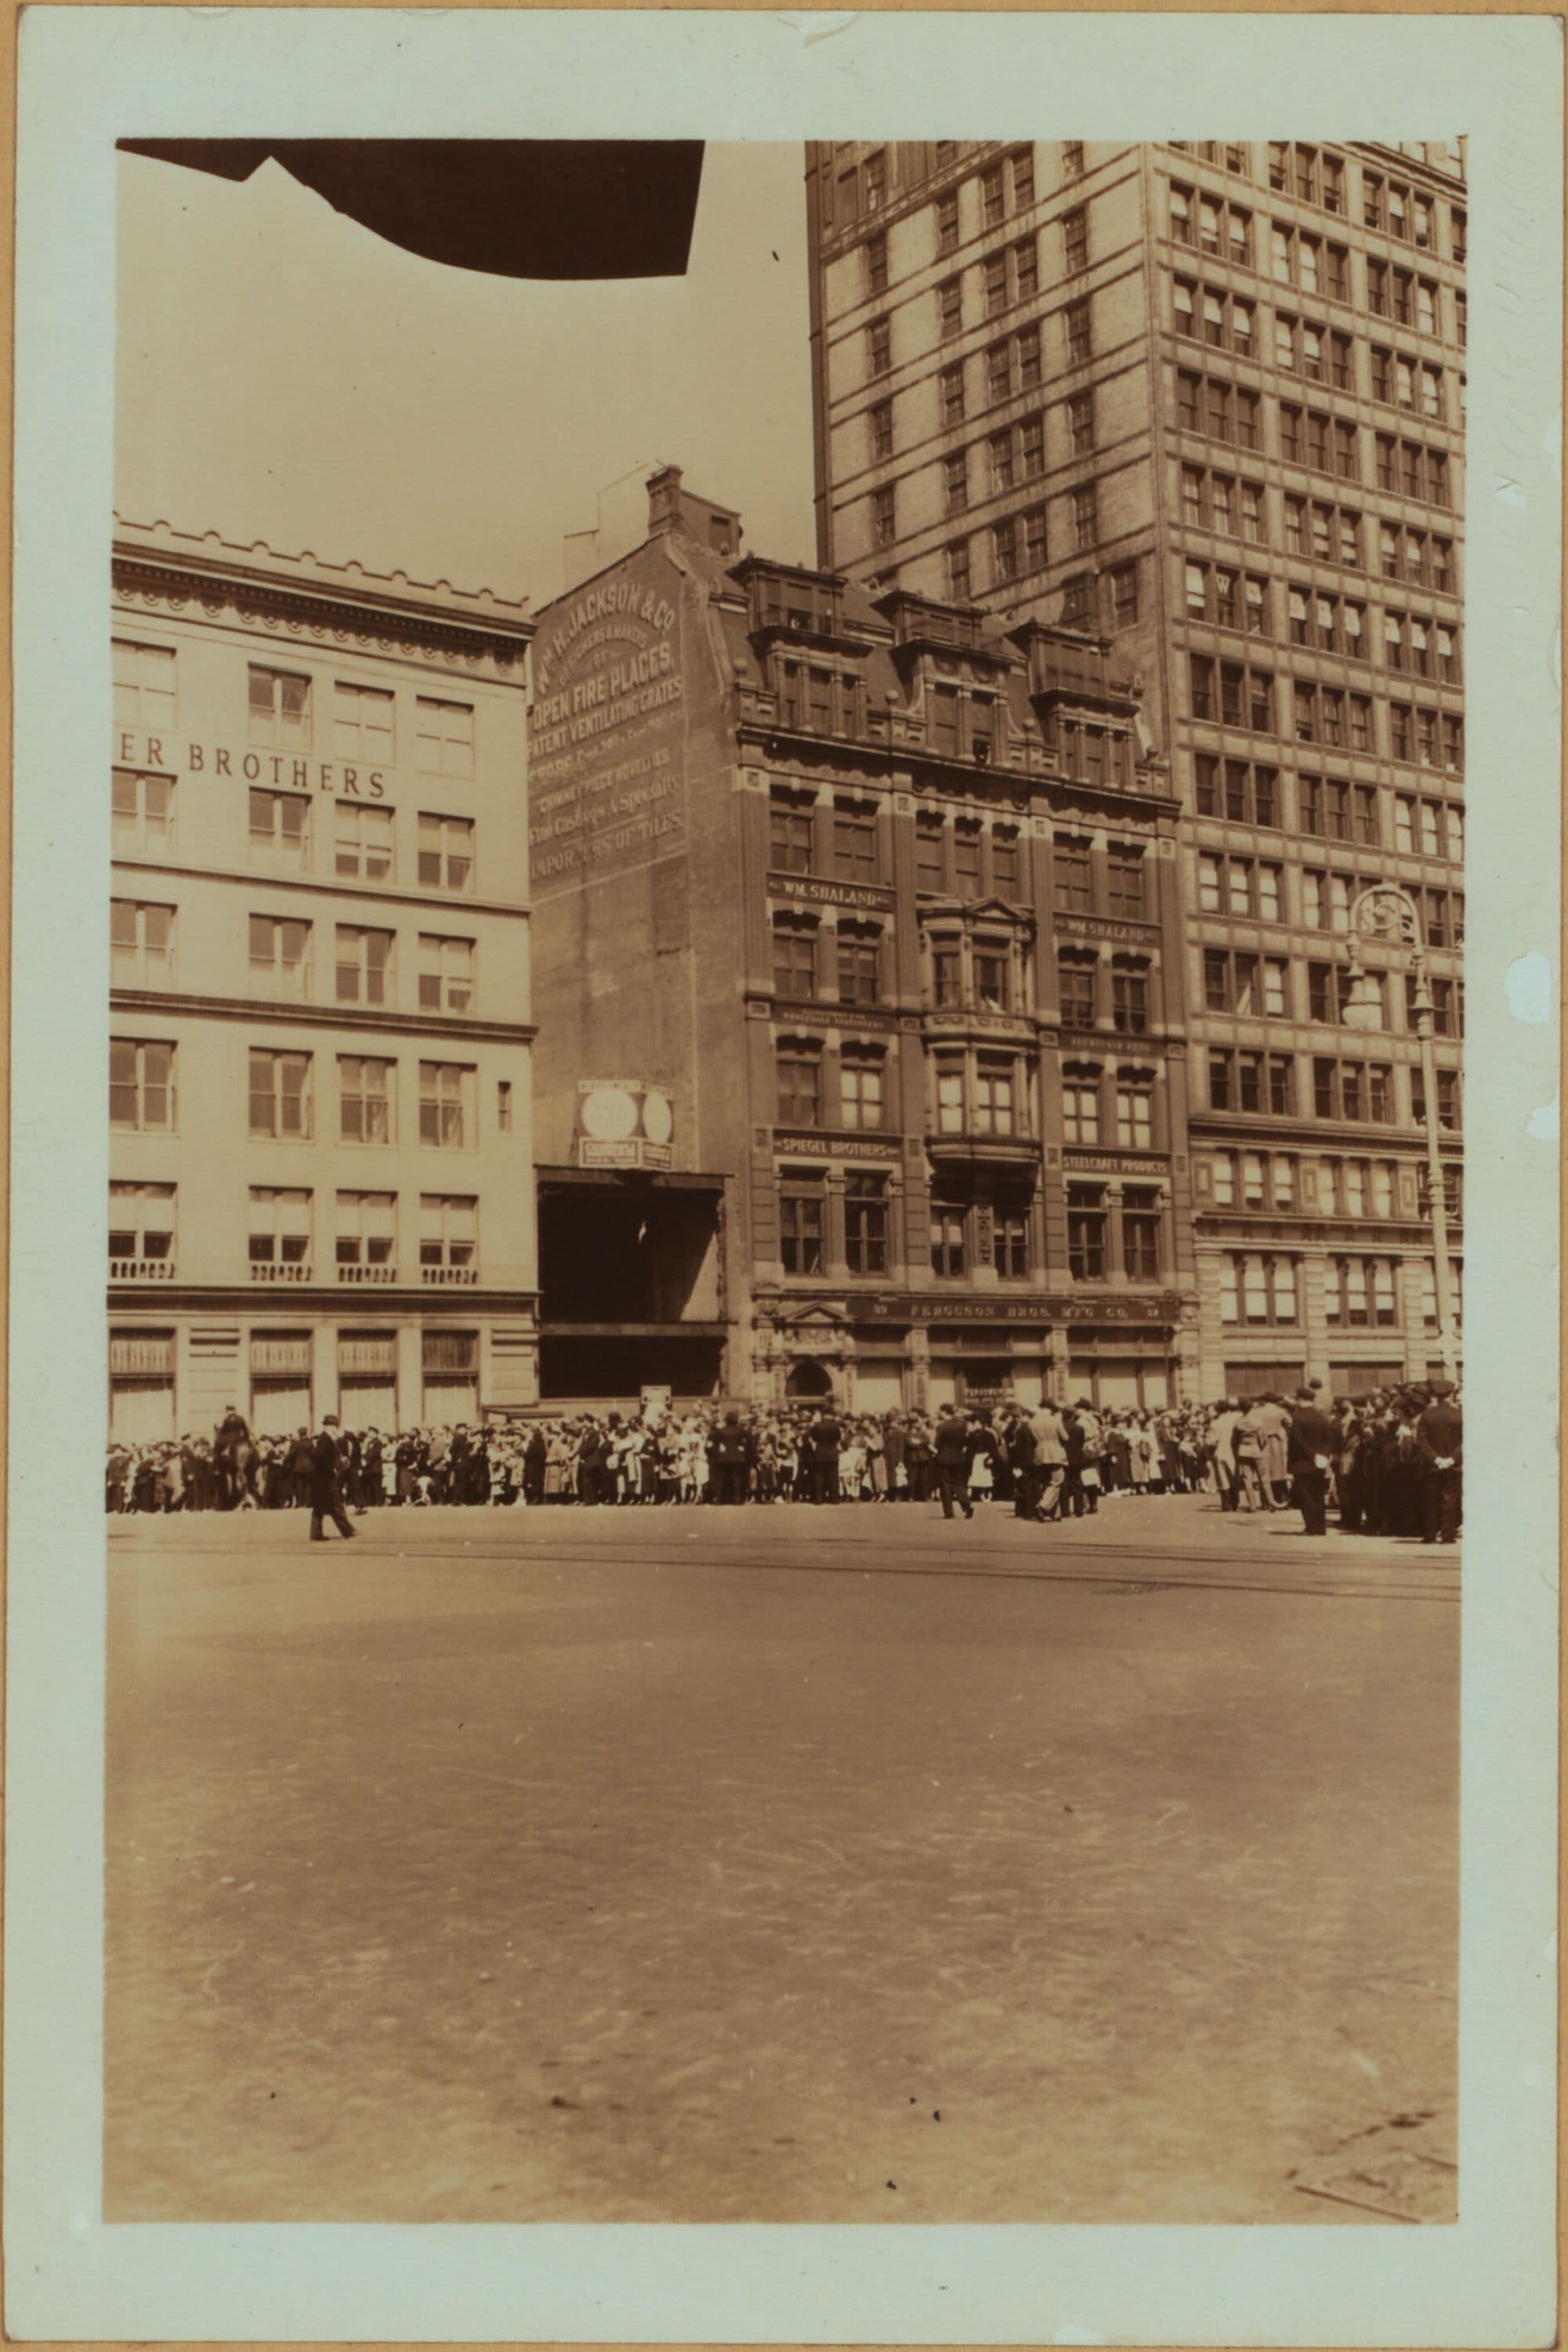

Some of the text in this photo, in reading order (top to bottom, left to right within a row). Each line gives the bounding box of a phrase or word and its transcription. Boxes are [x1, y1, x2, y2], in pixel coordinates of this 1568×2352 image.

[569, 582, 641, 639] JACKSON
[641, 589, 656, 622] &
[533, 690, 570, 730] OPEN
[574, 673, 607, 712] FIRE
[527, 726, 567, 760] PATENT
[570, 696, 639, 743] VENTILATING
[640, 675, 683, 712] GRATES
[121, 732, 384, 799] ER BROTHERS
[583, 770, 614, 795] PIECE
[610, 797, 619, 814] A
[616, 827, 635, 850] OF
[809, 885, 876, 906] SHALAND
[1088, 922, 1144, 941] SHALAND
[783, 1138, 886, 1157] SPIEGEL BROTHERS
[1063, 1156, 1168, 1173] STEELCRAFT PRODUCTS
[911, 1305, 995, 1317] FERGUSON
